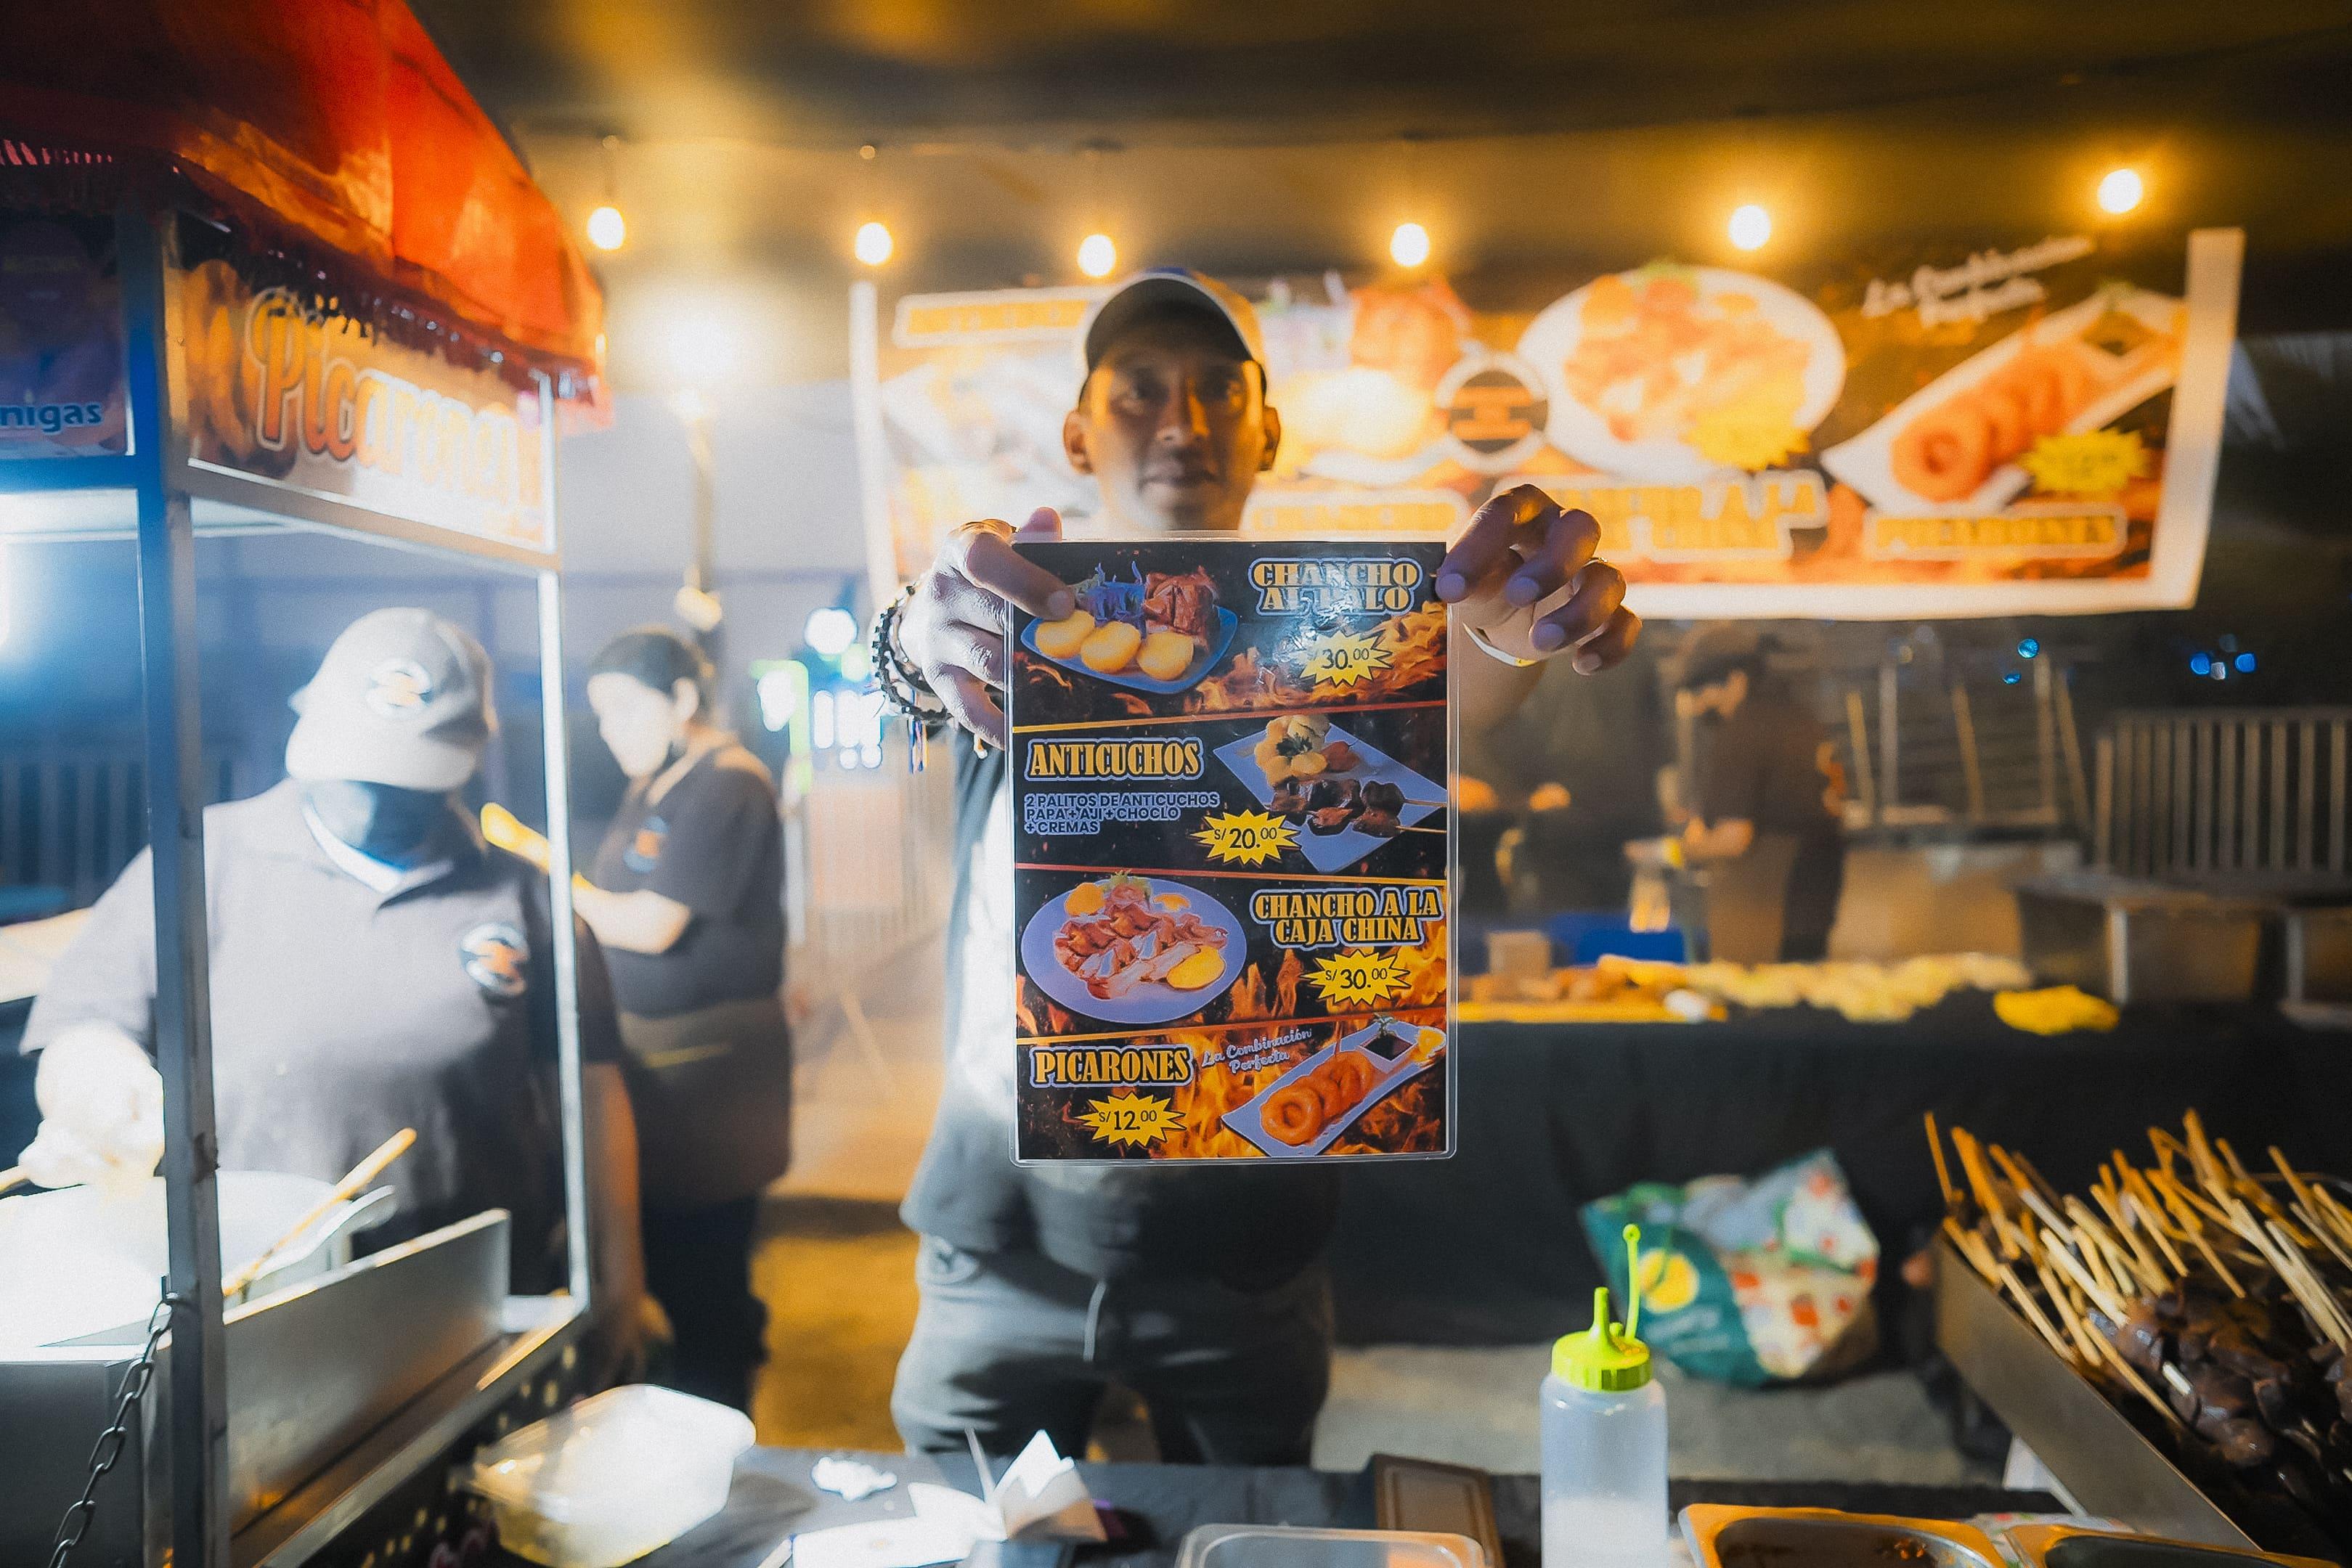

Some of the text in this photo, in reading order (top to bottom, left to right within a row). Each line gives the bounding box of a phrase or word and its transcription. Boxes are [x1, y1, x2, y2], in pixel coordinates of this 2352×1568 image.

[1253, 562, 1418, 587] CHANCHO
[1029, 741, 1200, 777] ANTICUCHOS
[1026, 793, 1220, 808] 2 PALITOS DE ANTICUCHOS
[1026, 807, 1067, 821] PAPA
[1079, 807, 1102, 821] AJI
[1117, 807, 1180, 820] CHOCLO
[1038, 821, 1099, 833] CREMAS
[1254, 891, 1439, 919] CHANCHO A LA
[1274, 917, 1420, 945] CAJA CHINA
[1034, 1049, 1190, 1083] PICARONES
[1201, 1050, 1226, 1068] La
[1229, 1049, 1290, 1074] Perfecta
